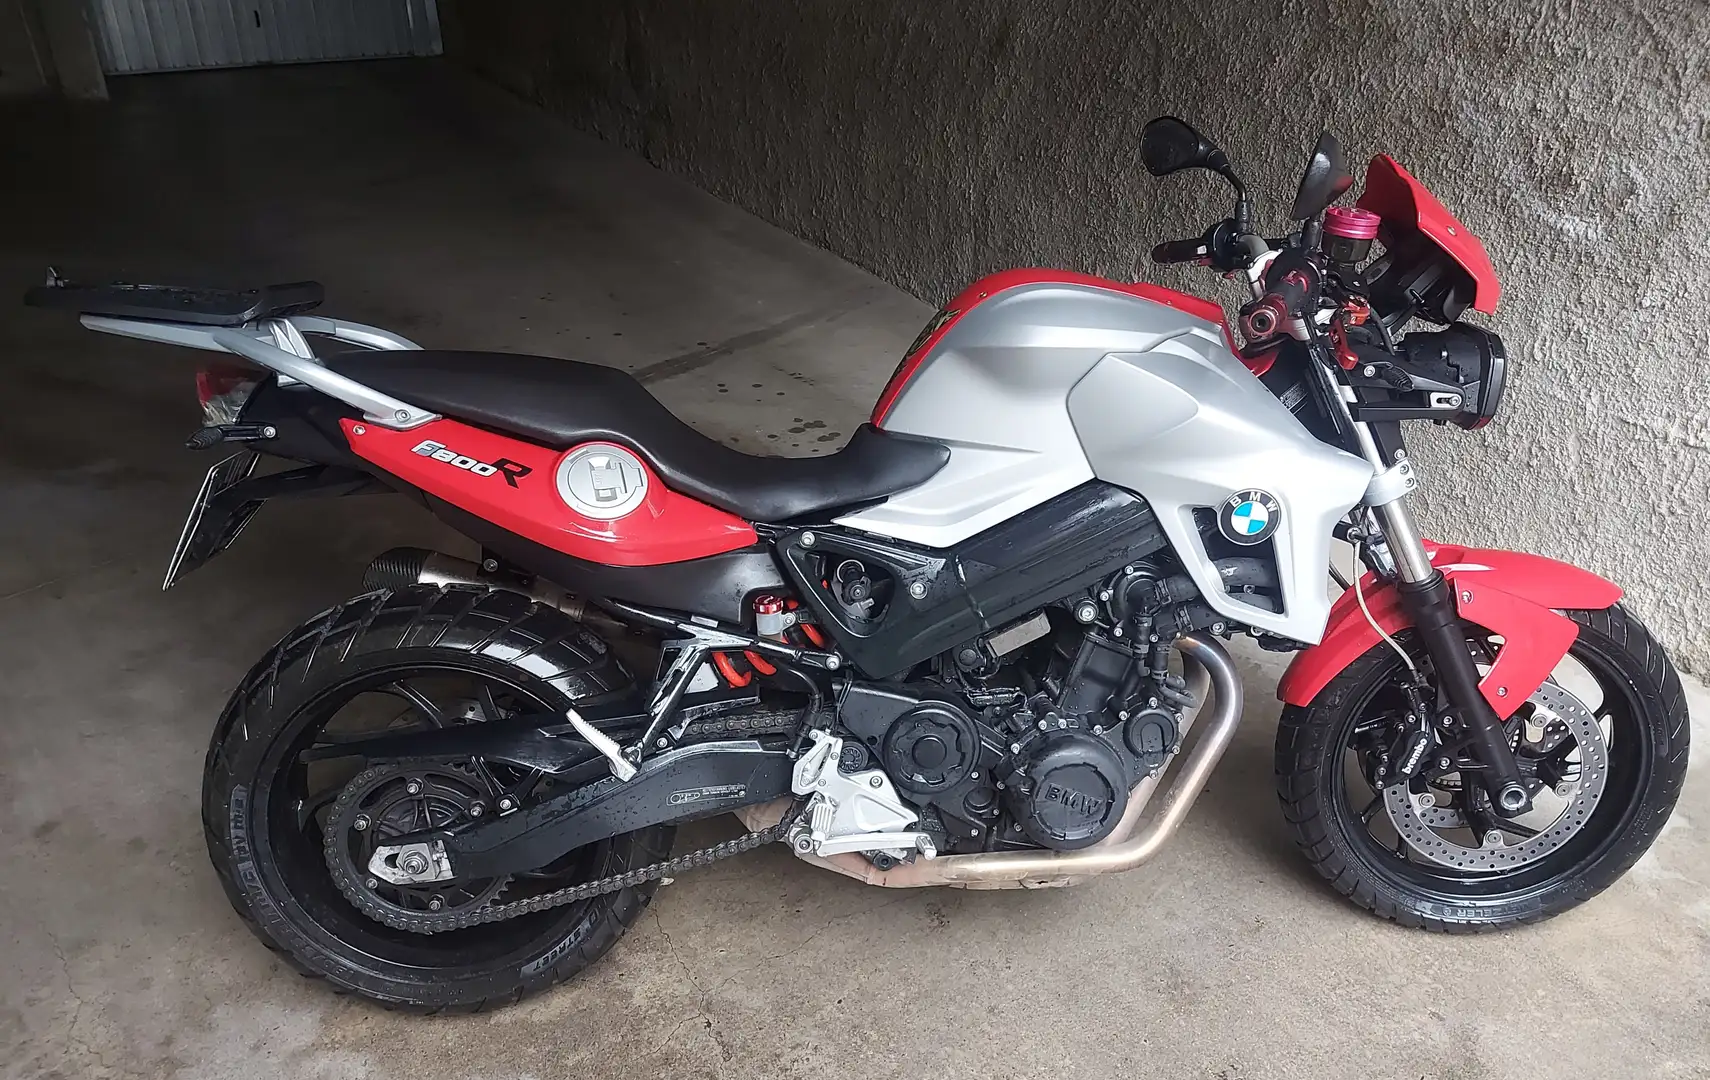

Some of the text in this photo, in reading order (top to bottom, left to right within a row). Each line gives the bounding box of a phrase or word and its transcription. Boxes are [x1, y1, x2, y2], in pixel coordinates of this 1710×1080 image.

[1229, 491, 1278, 513] BMW
[1401, 738, 1427, 774] brembo
[1045, 783, 1101, 815] BMW
[532, 927, 582, 972] STREET
